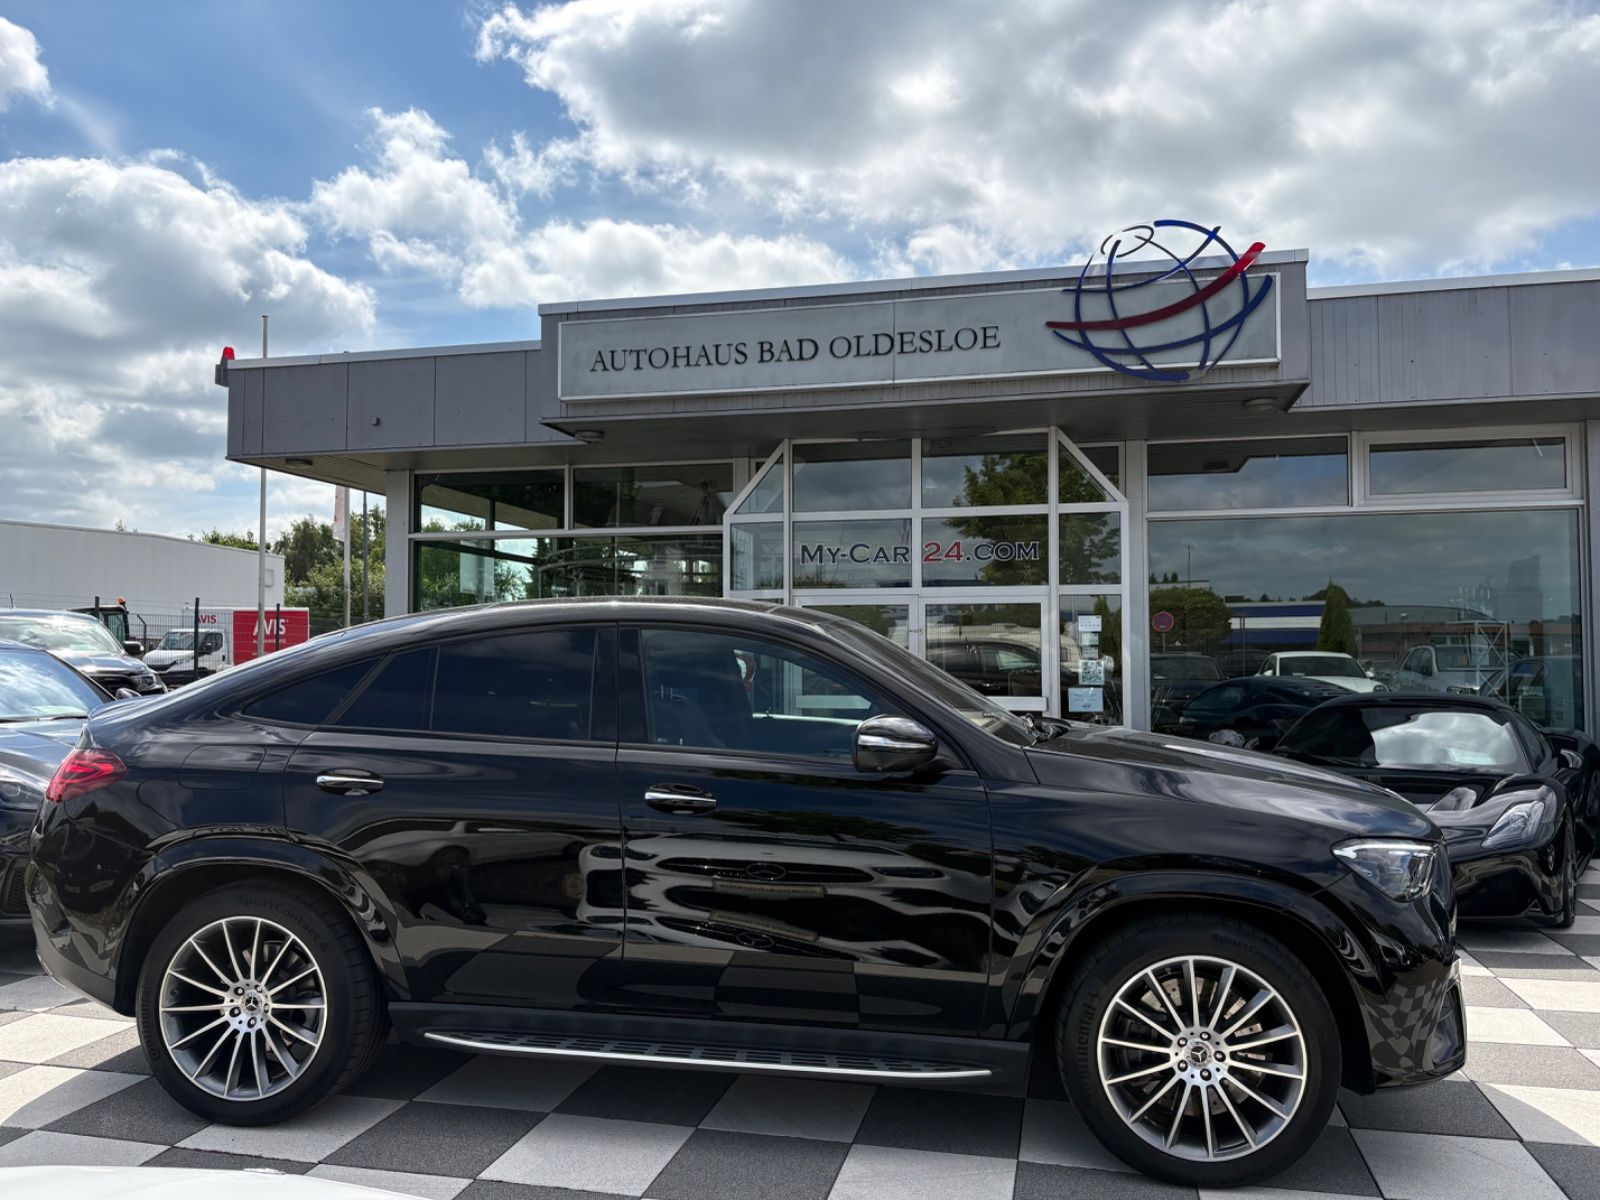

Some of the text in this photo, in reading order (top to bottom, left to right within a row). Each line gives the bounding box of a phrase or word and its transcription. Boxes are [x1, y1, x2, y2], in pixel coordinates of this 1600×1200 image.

[590, 325, 1001, 373] AUTOHAUS BAD OLDESLOE
